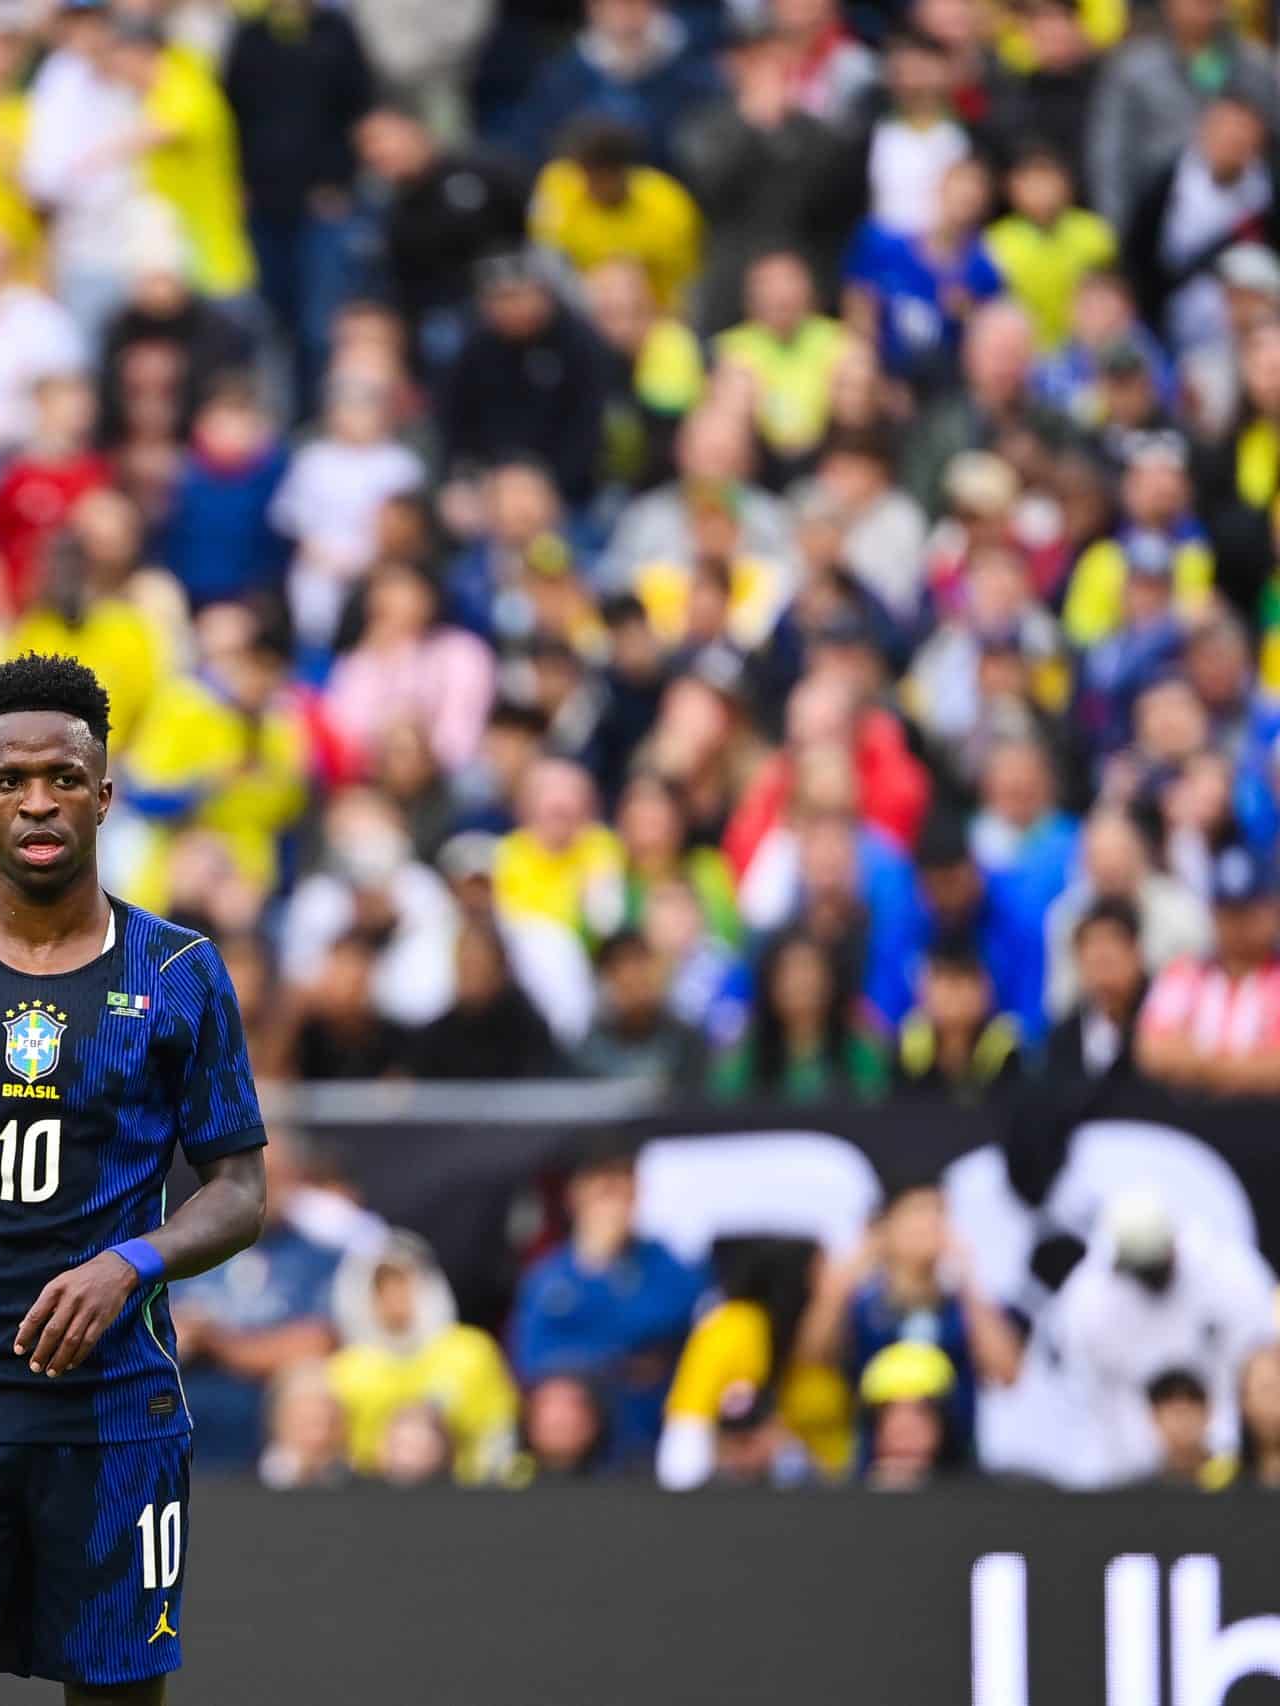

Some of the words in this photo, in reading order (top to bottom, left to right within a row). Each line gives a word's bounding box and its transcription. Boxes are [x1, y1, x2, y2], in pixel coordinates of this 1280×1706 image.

[23, 1039, 43, 1049] CBF
[2, 1083, 60, 1099] BRASIL
[137, 1501, 181, 1588] 10
